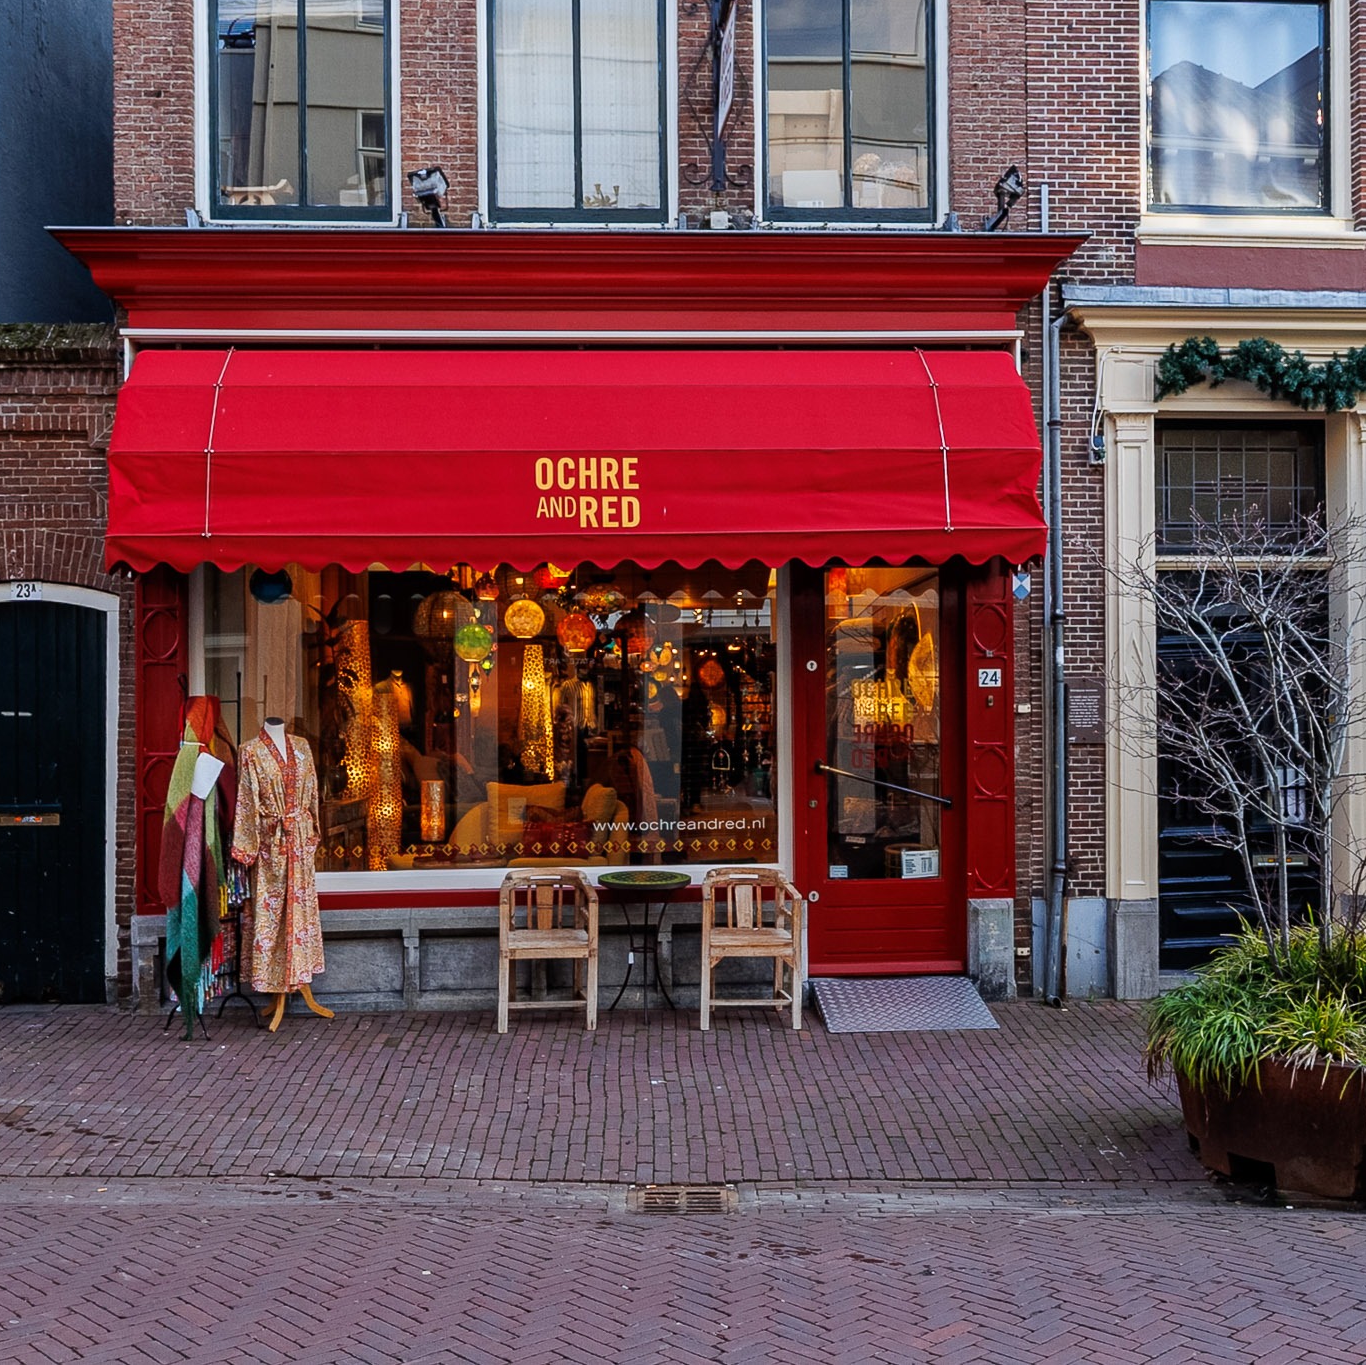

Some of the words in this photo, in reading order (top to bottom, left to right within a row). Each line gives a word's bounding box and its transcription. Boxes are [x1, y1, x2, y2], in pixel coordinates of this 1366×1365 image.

[535, 457, 640, 490] OCHRE
[536, 496, 577, 518] AND
[579, 496, 641, 528] RED
[981, 670, 999, 685] 24
[592, 817, 766, 832] www.ochreandred.nl
